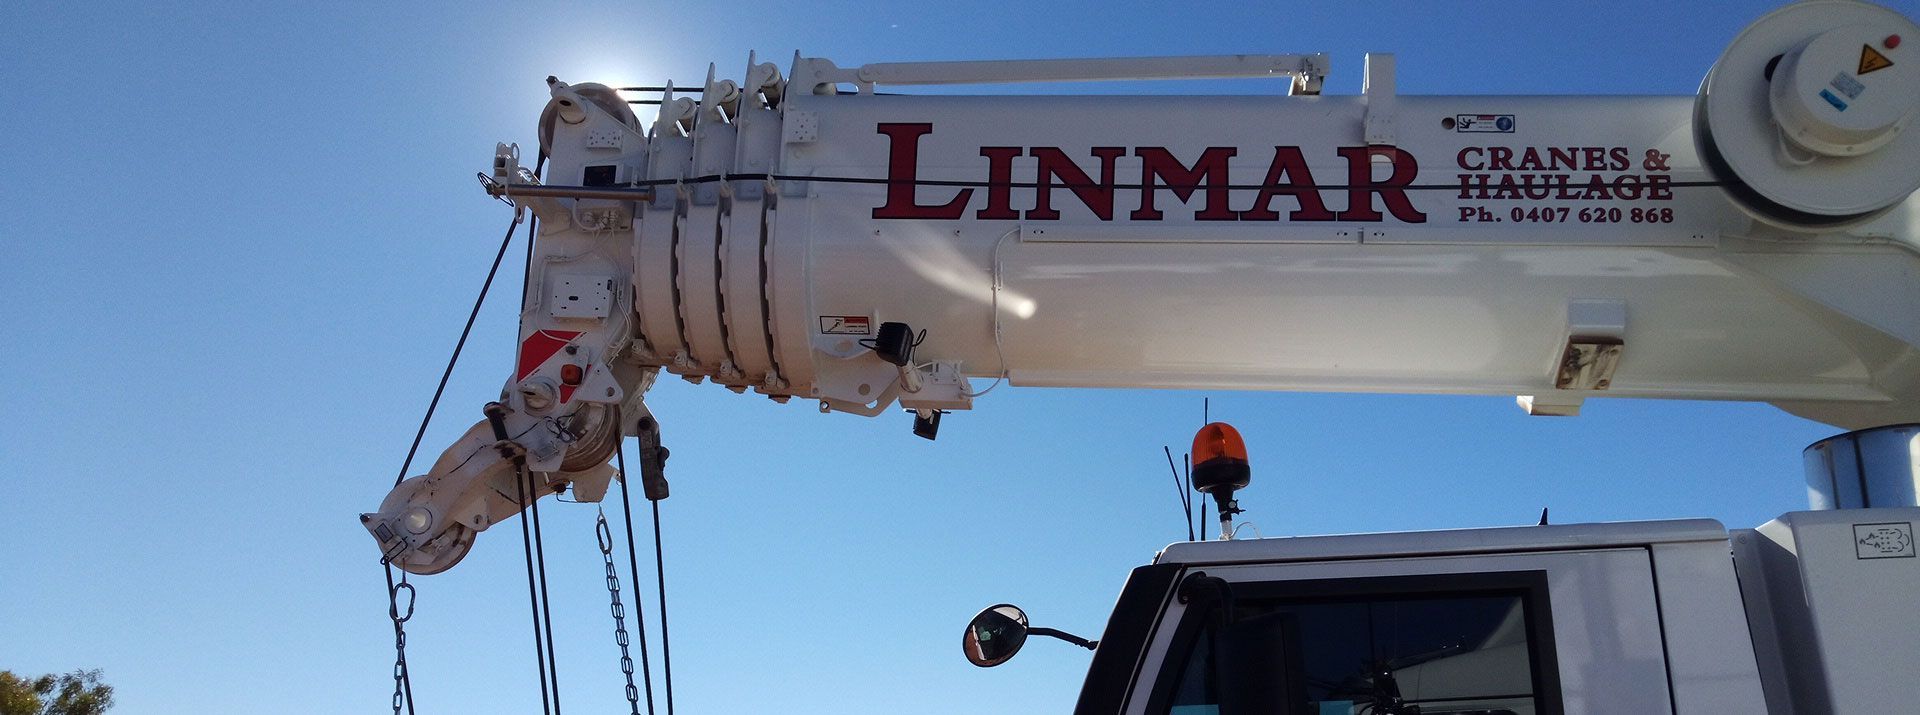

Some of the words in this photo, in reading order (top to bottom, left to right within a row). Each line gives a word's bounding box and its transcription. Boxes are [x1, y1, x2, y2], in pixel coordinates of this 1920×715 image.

[1457, 146, 1630, 171] CRANES
[1643, 148, 1671, 172] &
[872, 122, 1427, 224] LINMAR
[1457, 174, 1673, 200] HAULAGE
[1458, 206, 1502, 222] Ph.
[1511, 207, 1569, 223] 0407
[1578, 207, 1622, 223] 620
[1630, 207, 1674, 223] 868
